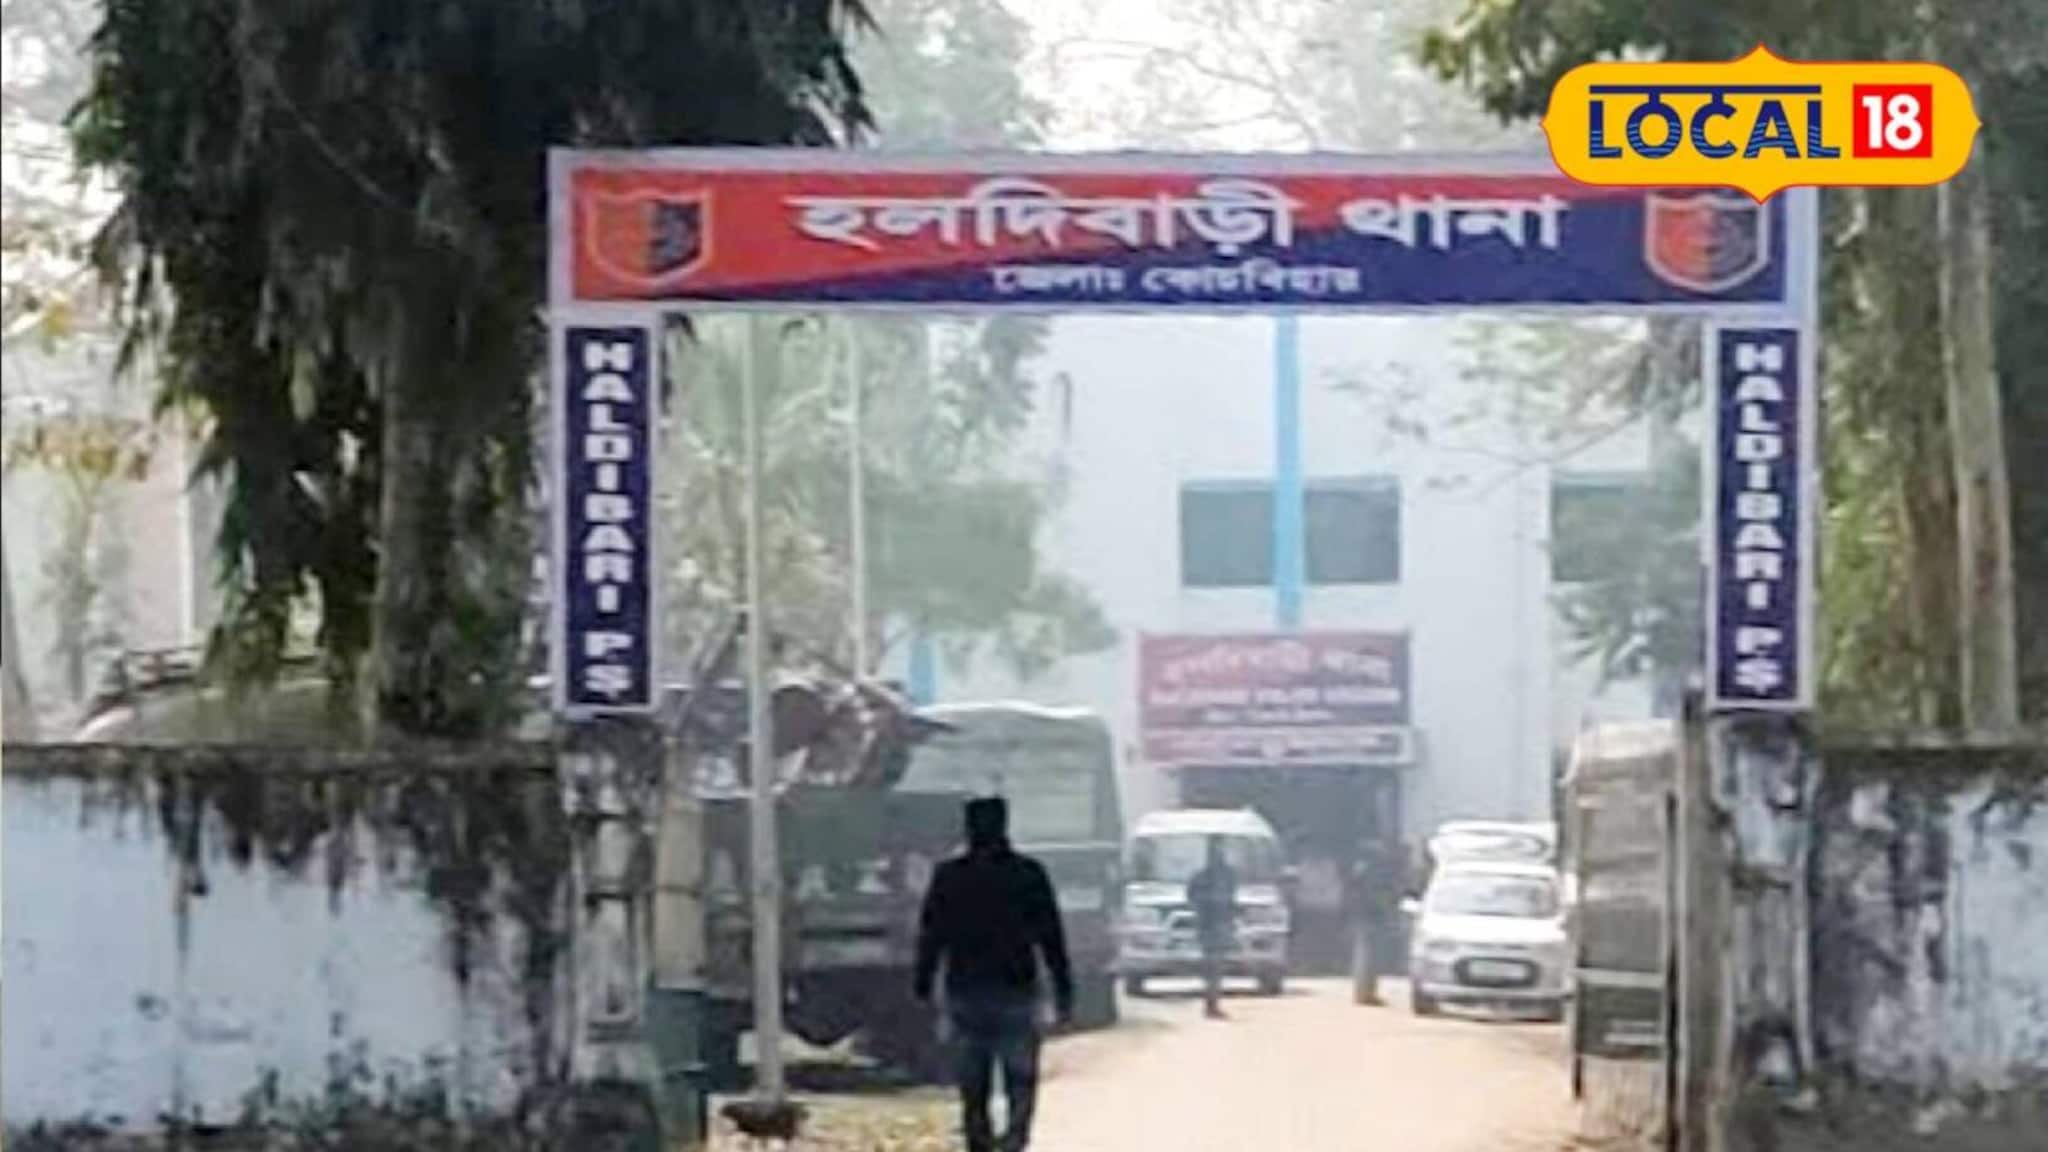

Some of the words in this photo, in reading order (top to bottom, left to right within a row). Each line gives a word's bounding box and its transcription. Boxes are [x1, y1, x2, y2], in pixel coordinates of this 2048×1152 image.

[781, 177, 1305, 255] হলদিবাড়ী
[1337, 194, 1571, 250] থানা
[582, 341, 635, 613] HALDIBARI
[1734, 342, 1784, 610] HALDIBARI
